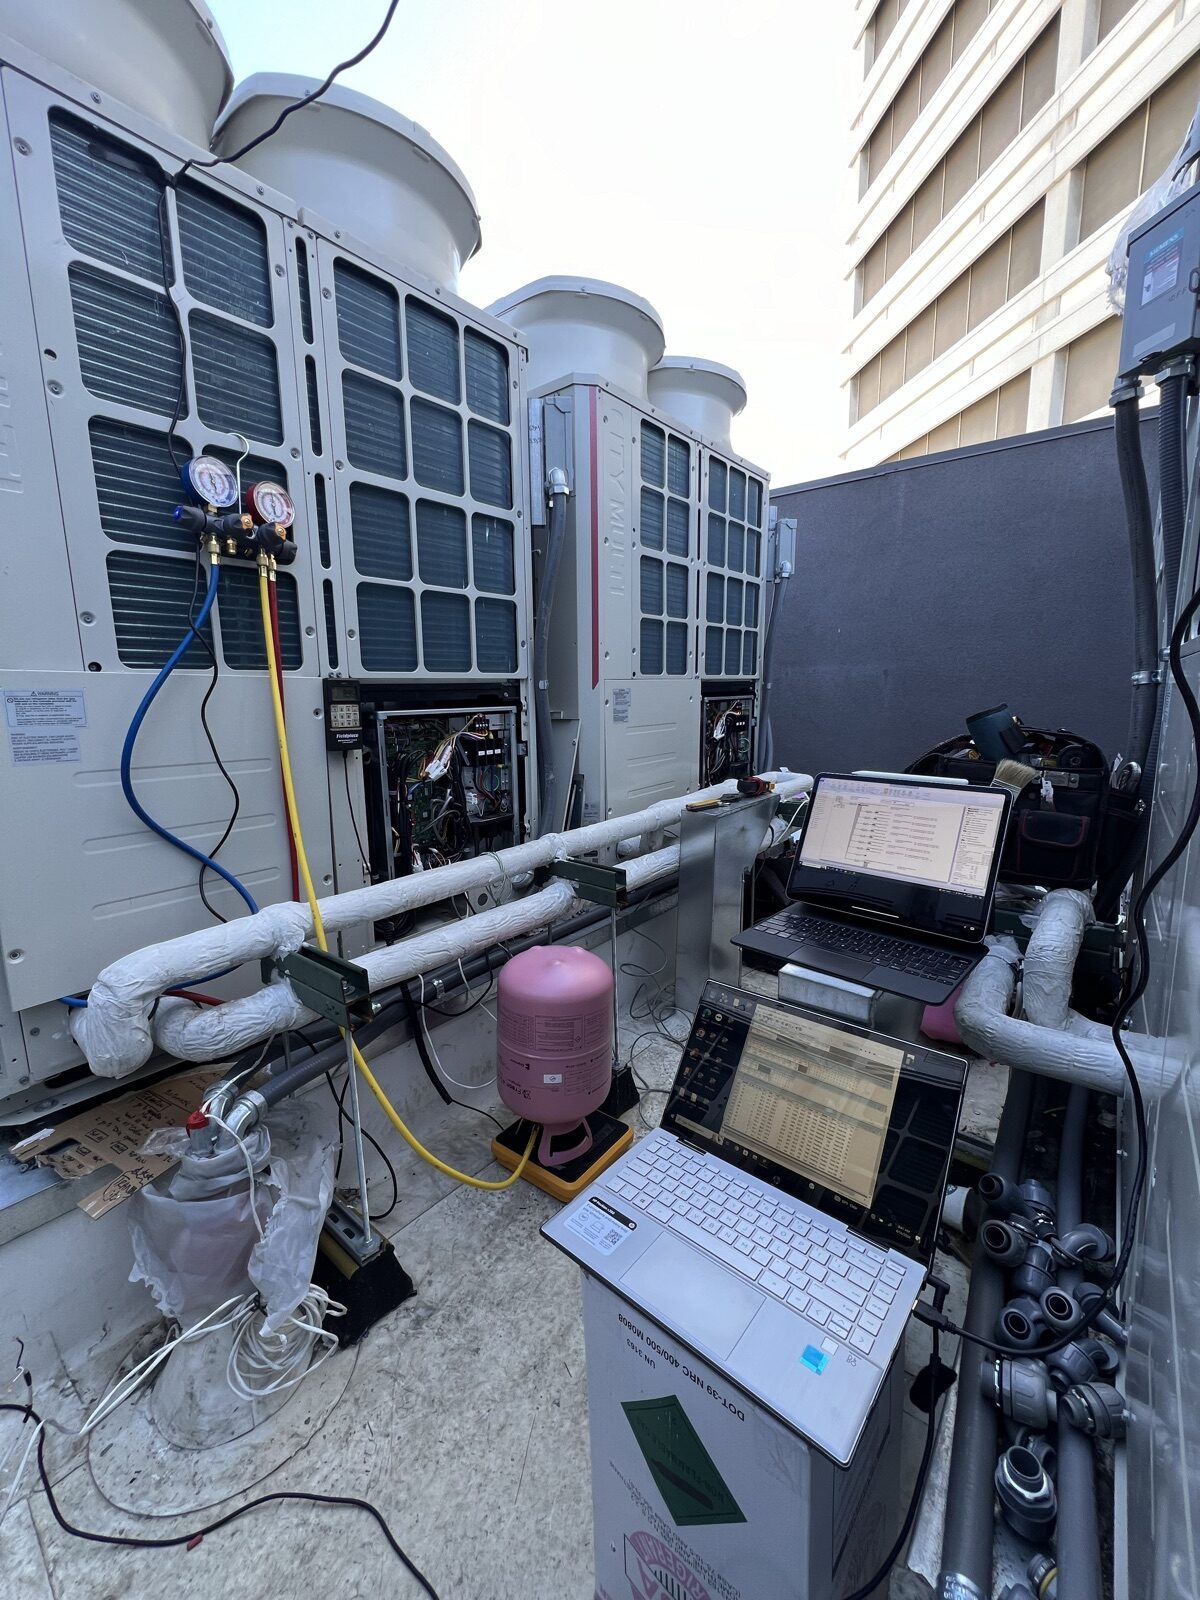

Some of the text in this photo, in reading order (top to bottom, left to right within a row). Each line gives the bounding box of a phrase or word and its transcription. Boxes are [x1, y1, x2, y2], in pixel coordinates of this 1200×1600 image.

[609, 497, 625, 598] MULTI
[618, 1313, 745, 1422] DOT-39 NRC 400/500 M0808
[626, 1338, 656, 1369] UN 3163
